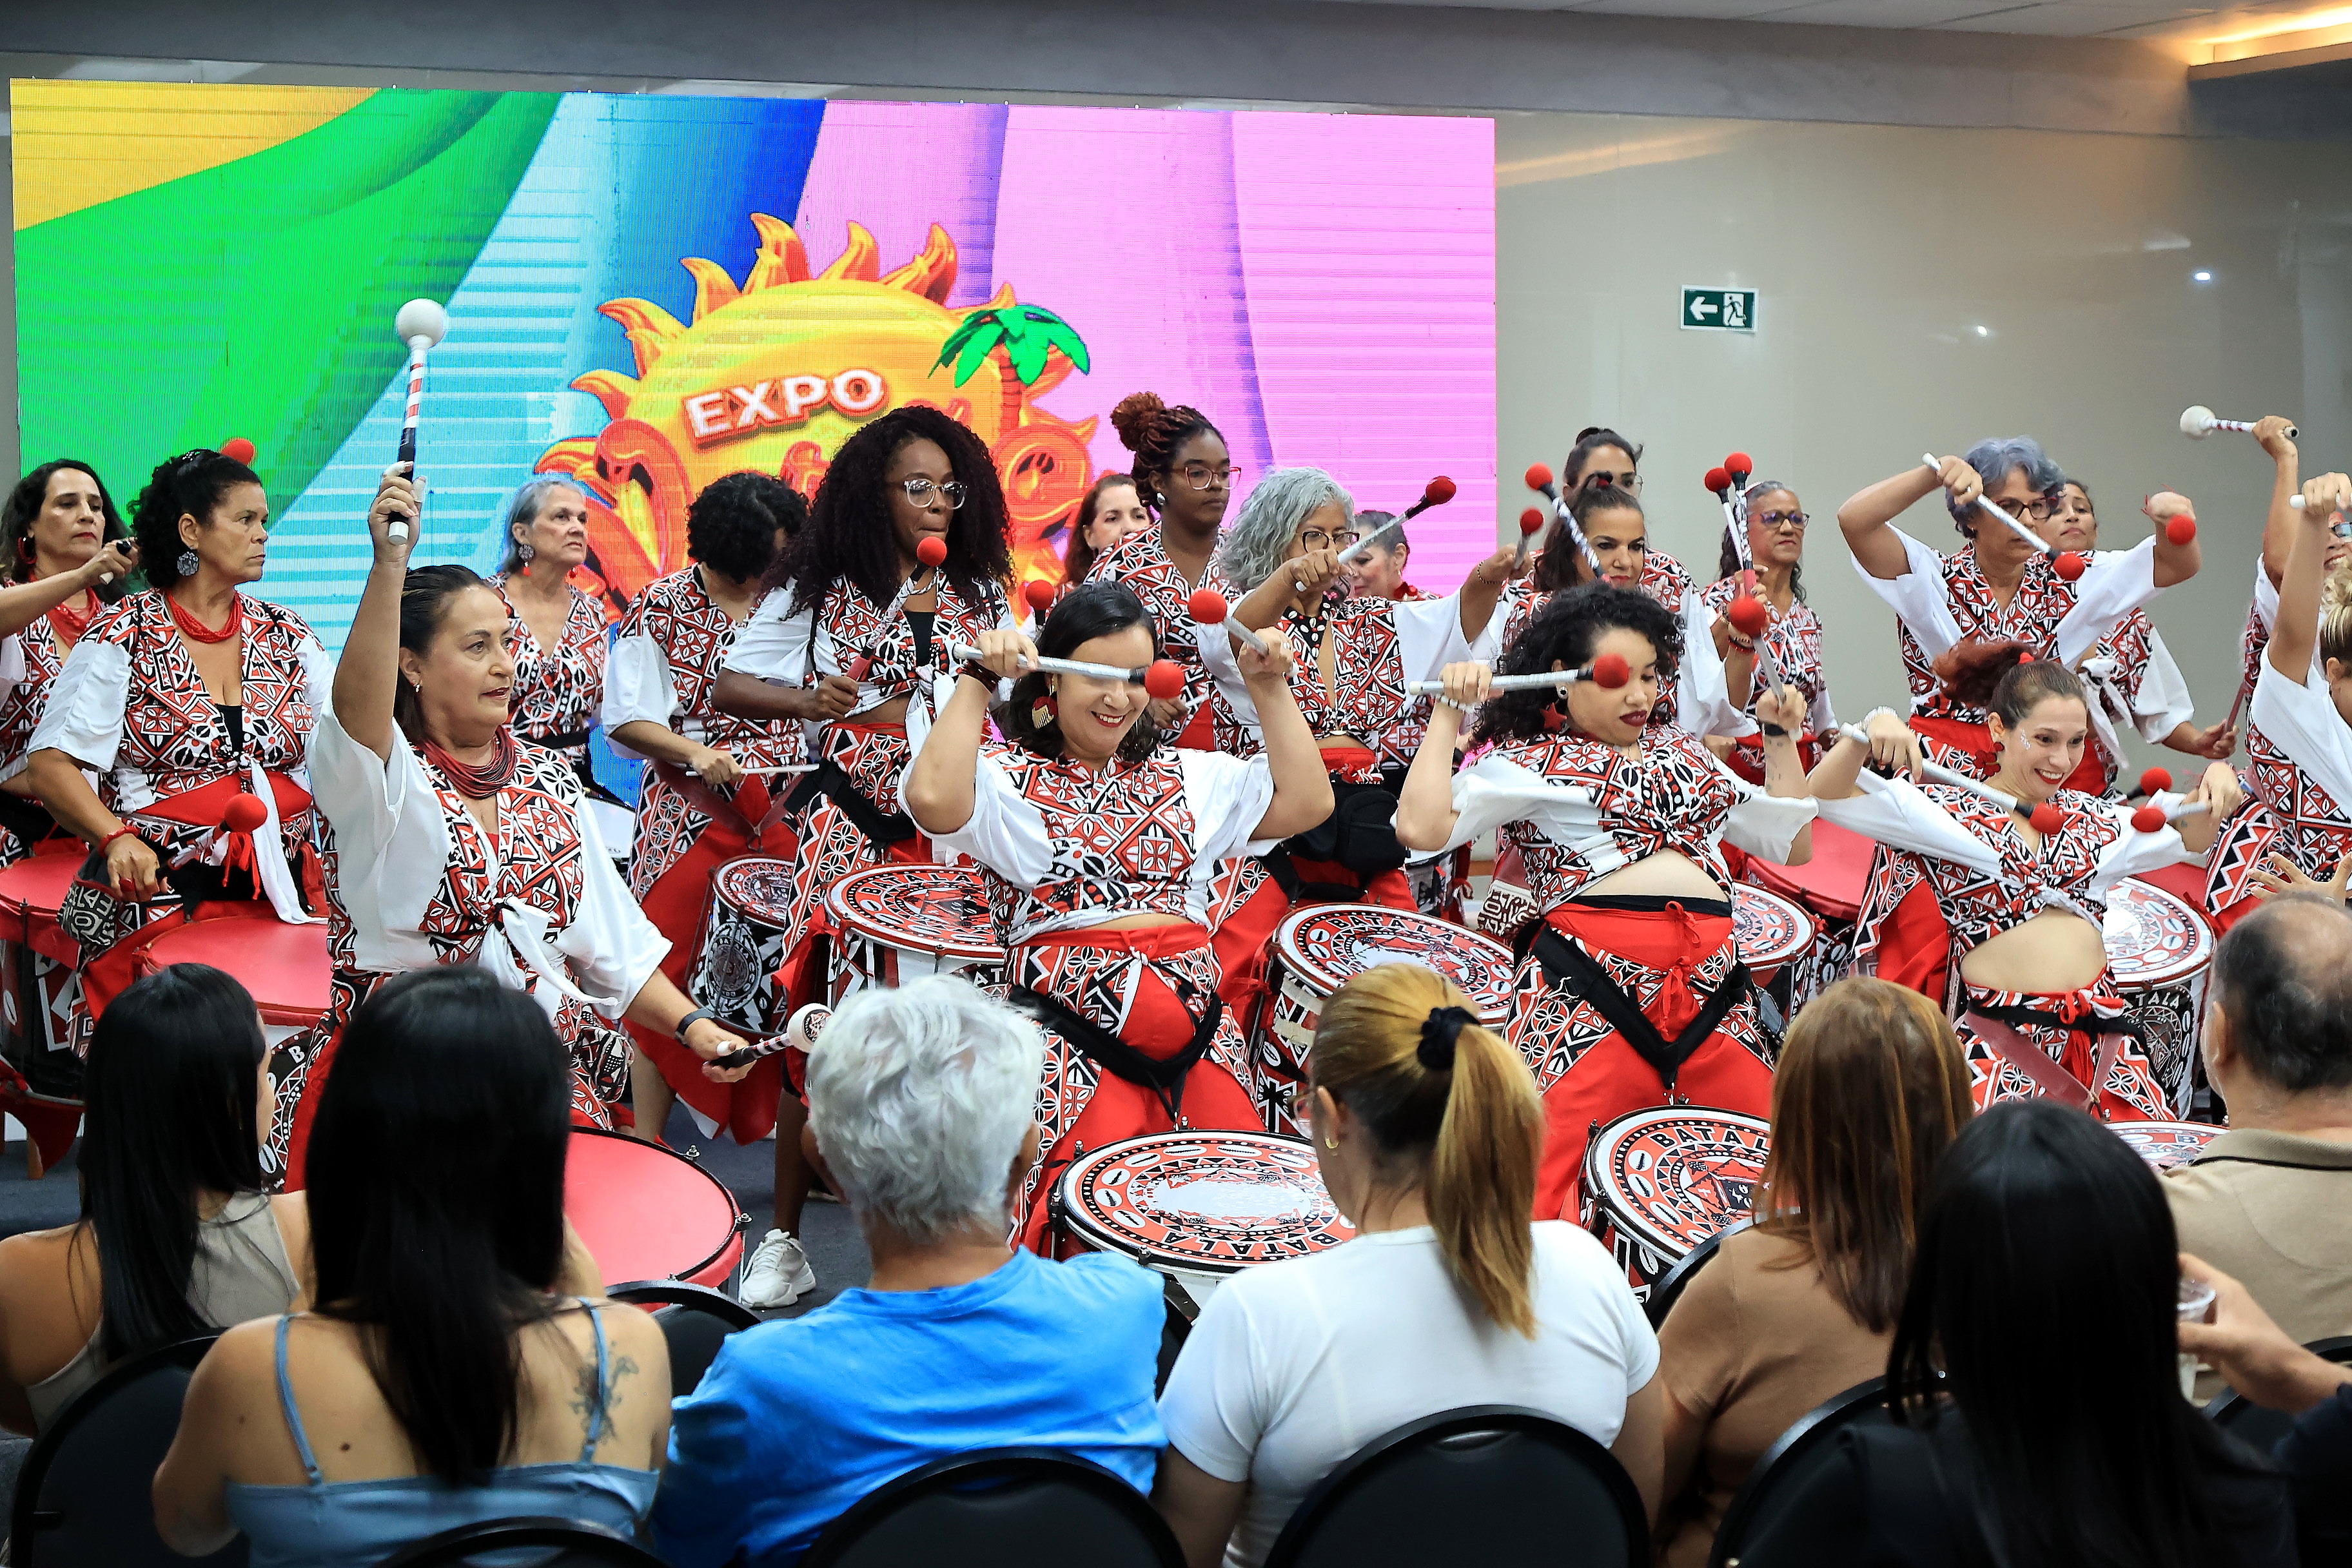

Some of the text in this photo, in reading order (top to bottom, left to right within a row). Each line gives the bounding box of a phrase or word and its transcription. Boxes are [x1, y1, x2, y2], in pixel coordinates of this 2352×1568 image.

[685, 368, 887, 440] EXPO
[858, 874, 973, 896] BATALA
[1328, 914, 1455, 943] BATALA
[1647, 1125, 1770, 1153] BATAL
[1162, 1231, 1345, 1257] BATALA
